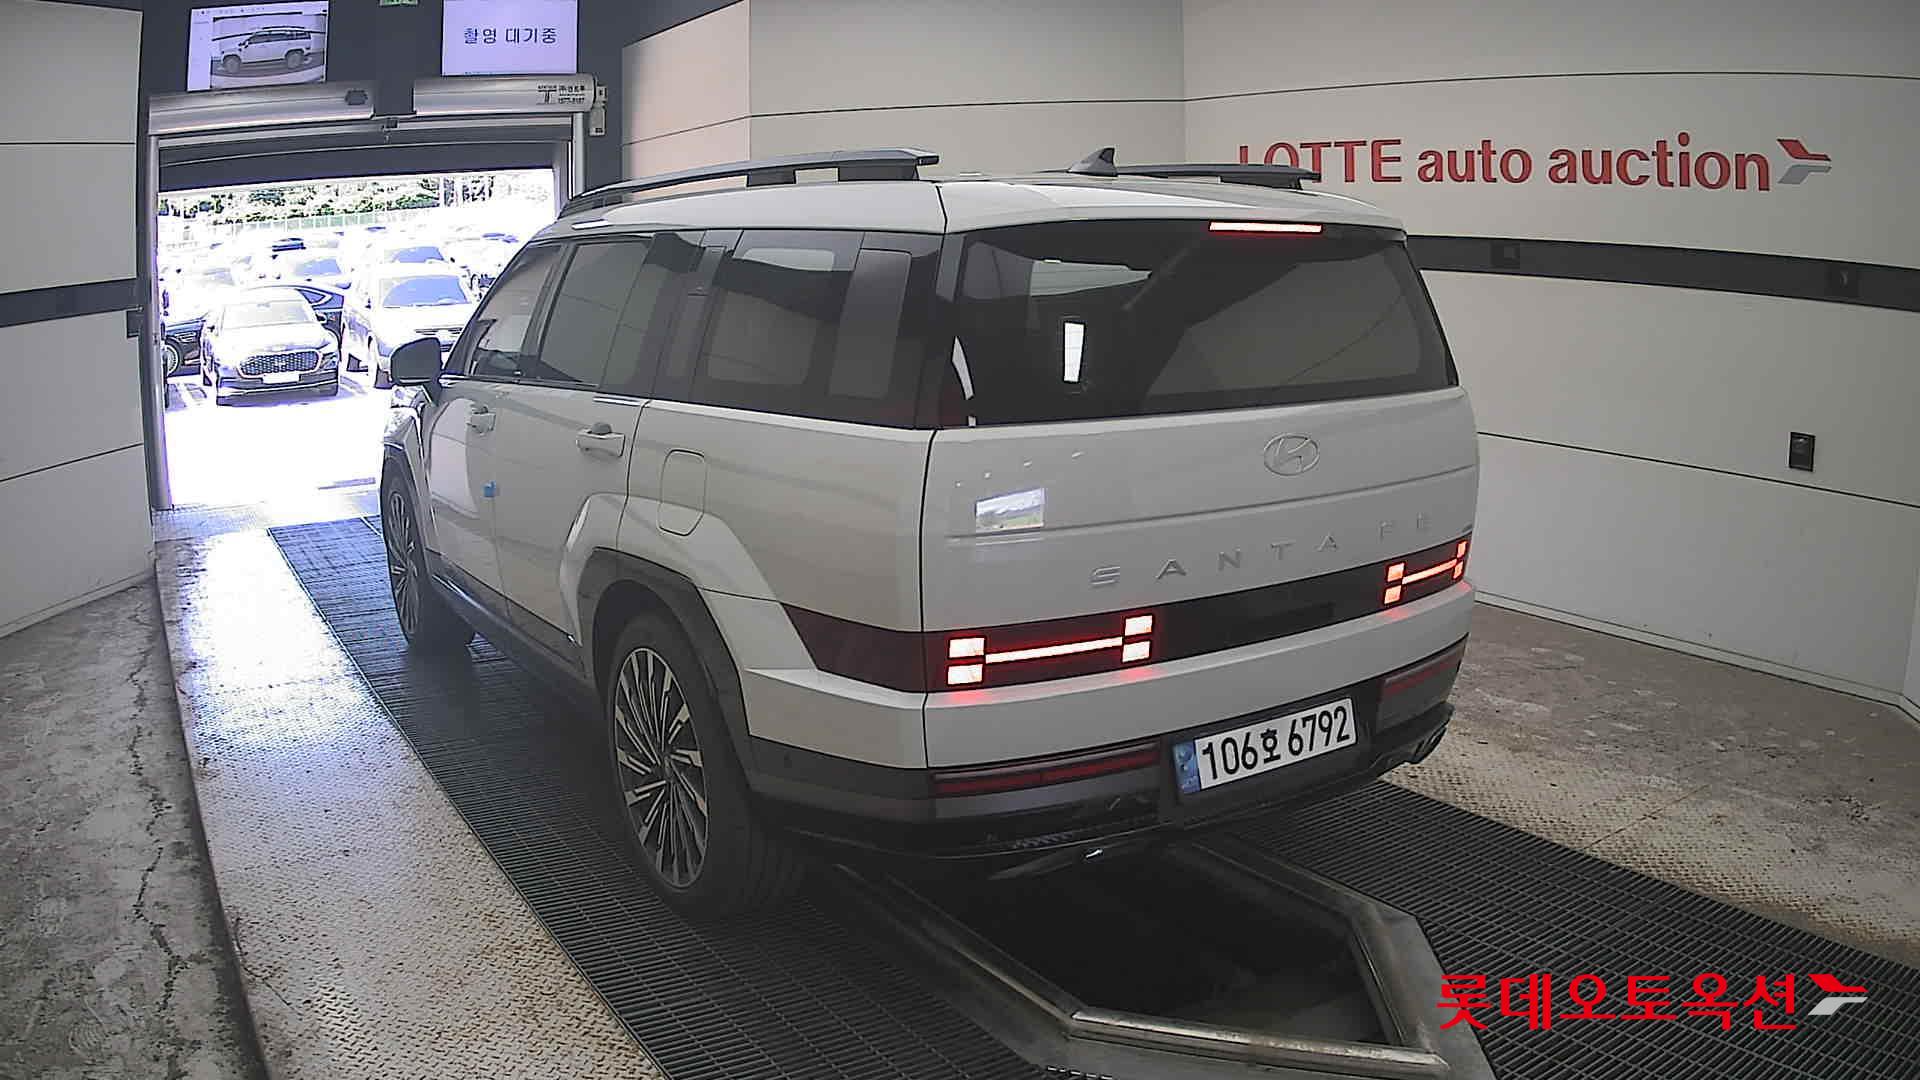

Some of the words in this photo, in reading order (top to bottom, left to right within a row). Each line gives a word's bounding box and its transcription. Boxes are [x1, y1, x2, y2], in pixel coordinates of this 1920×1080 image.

[505, 27, 557, 44] 대기중
[1418, 139, 1532, 183] auto
[1549, 132, 1770, 192] auction
[1089, 534, 1338, 589] SANTA
[1287, 705, 1350, 756] 6792
